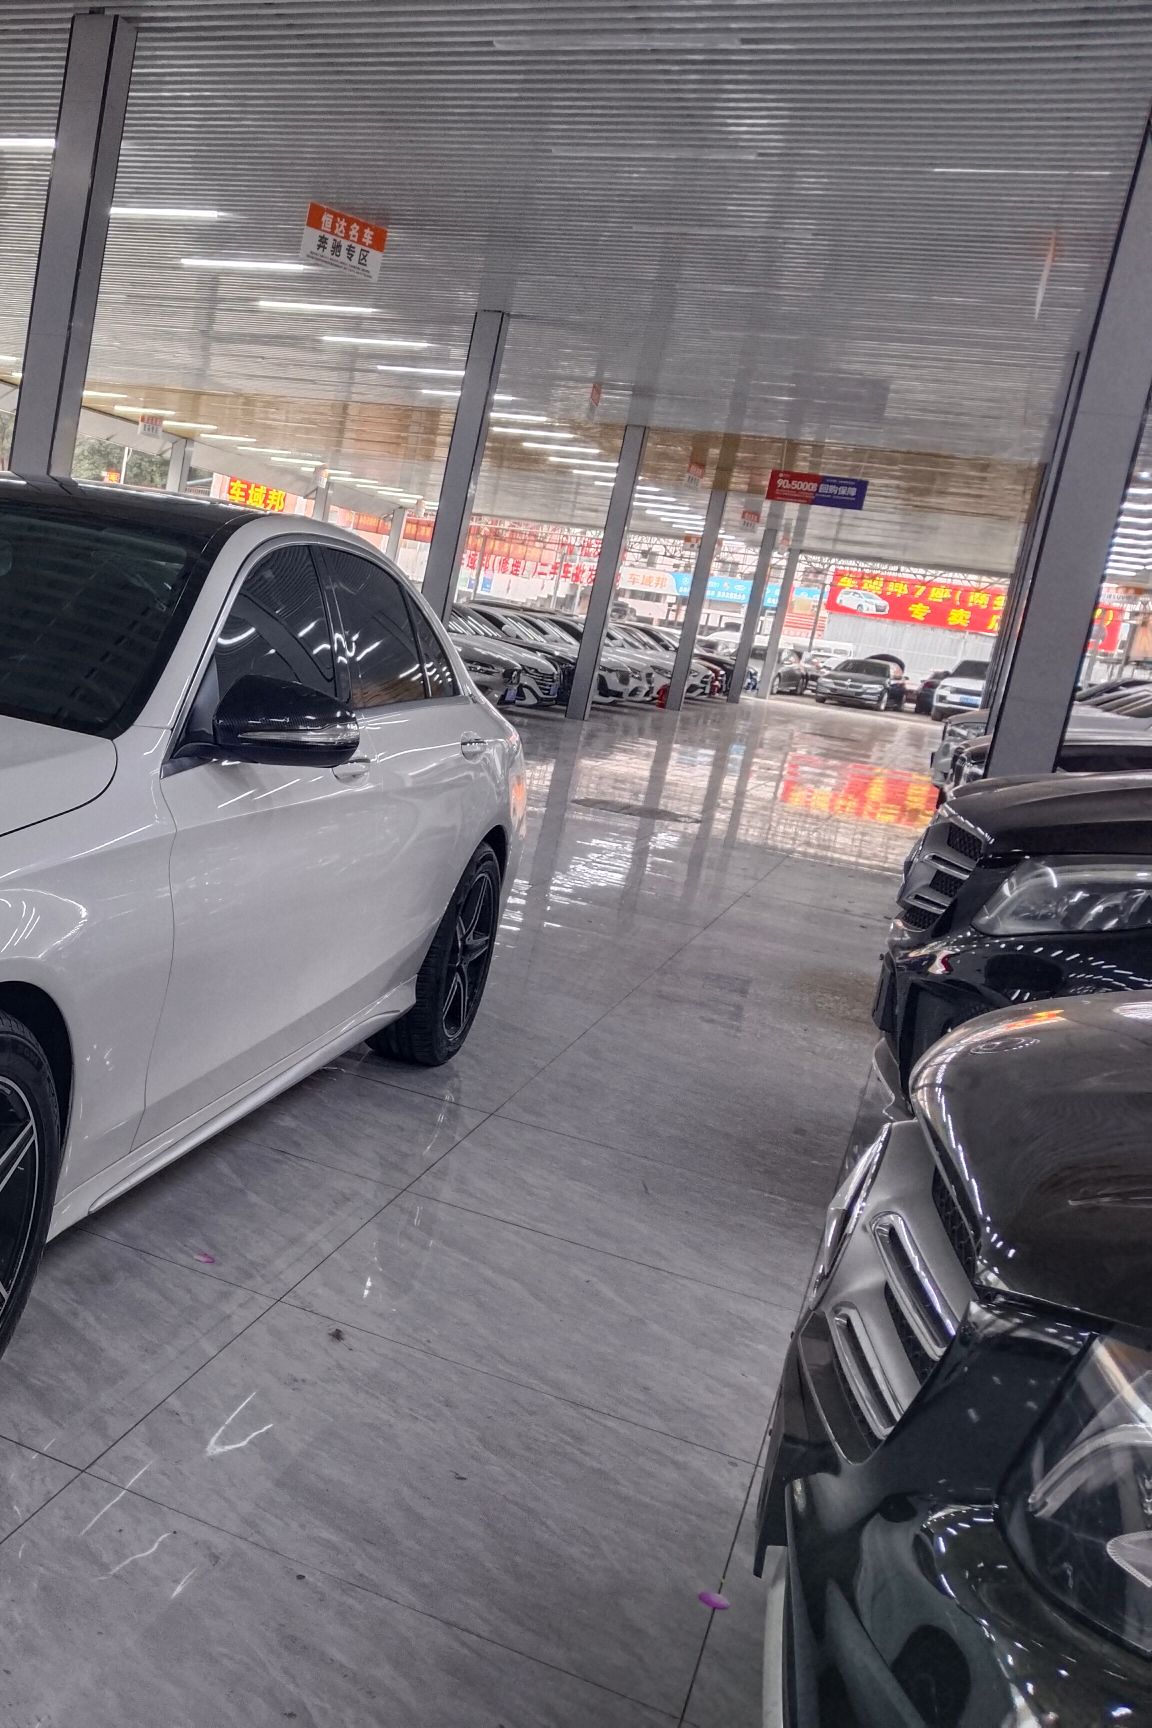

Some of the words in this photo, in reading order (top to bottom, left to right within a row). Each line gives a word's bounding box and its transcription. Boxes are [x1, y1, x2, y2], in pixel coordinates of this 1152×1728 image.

[321, 212, 374, 246] 恒达名车
[316, 234, 370, 267] 奔驰专区
[229, 480, 285, 512] 车域邦
[818, 483, 857, 496] 回购保障
